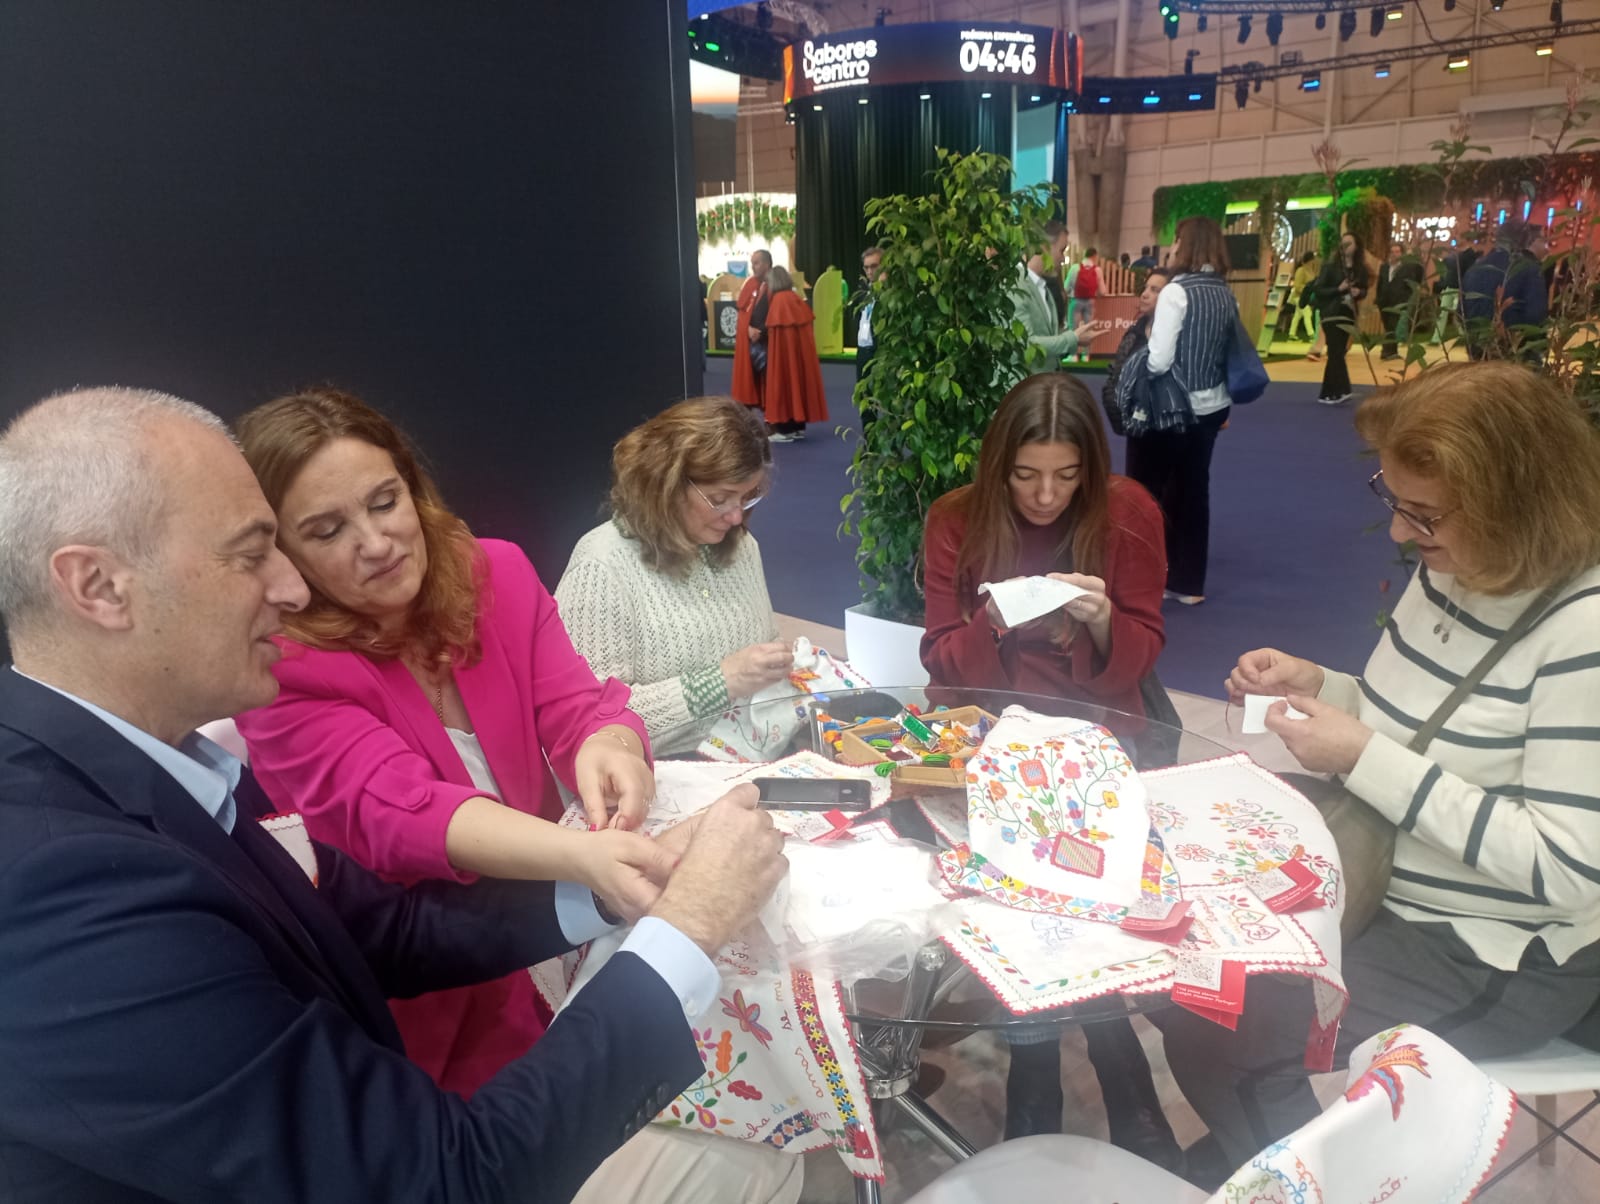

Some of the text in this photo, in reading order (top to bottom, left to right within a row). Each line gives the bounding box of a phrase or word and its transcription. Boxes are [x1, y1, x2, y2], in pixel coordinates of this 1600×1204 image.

[802, 39, 878, 73] Sabores
[813, 59, 870, 84] centro
[959, 40, 1037, 75] 04:46
